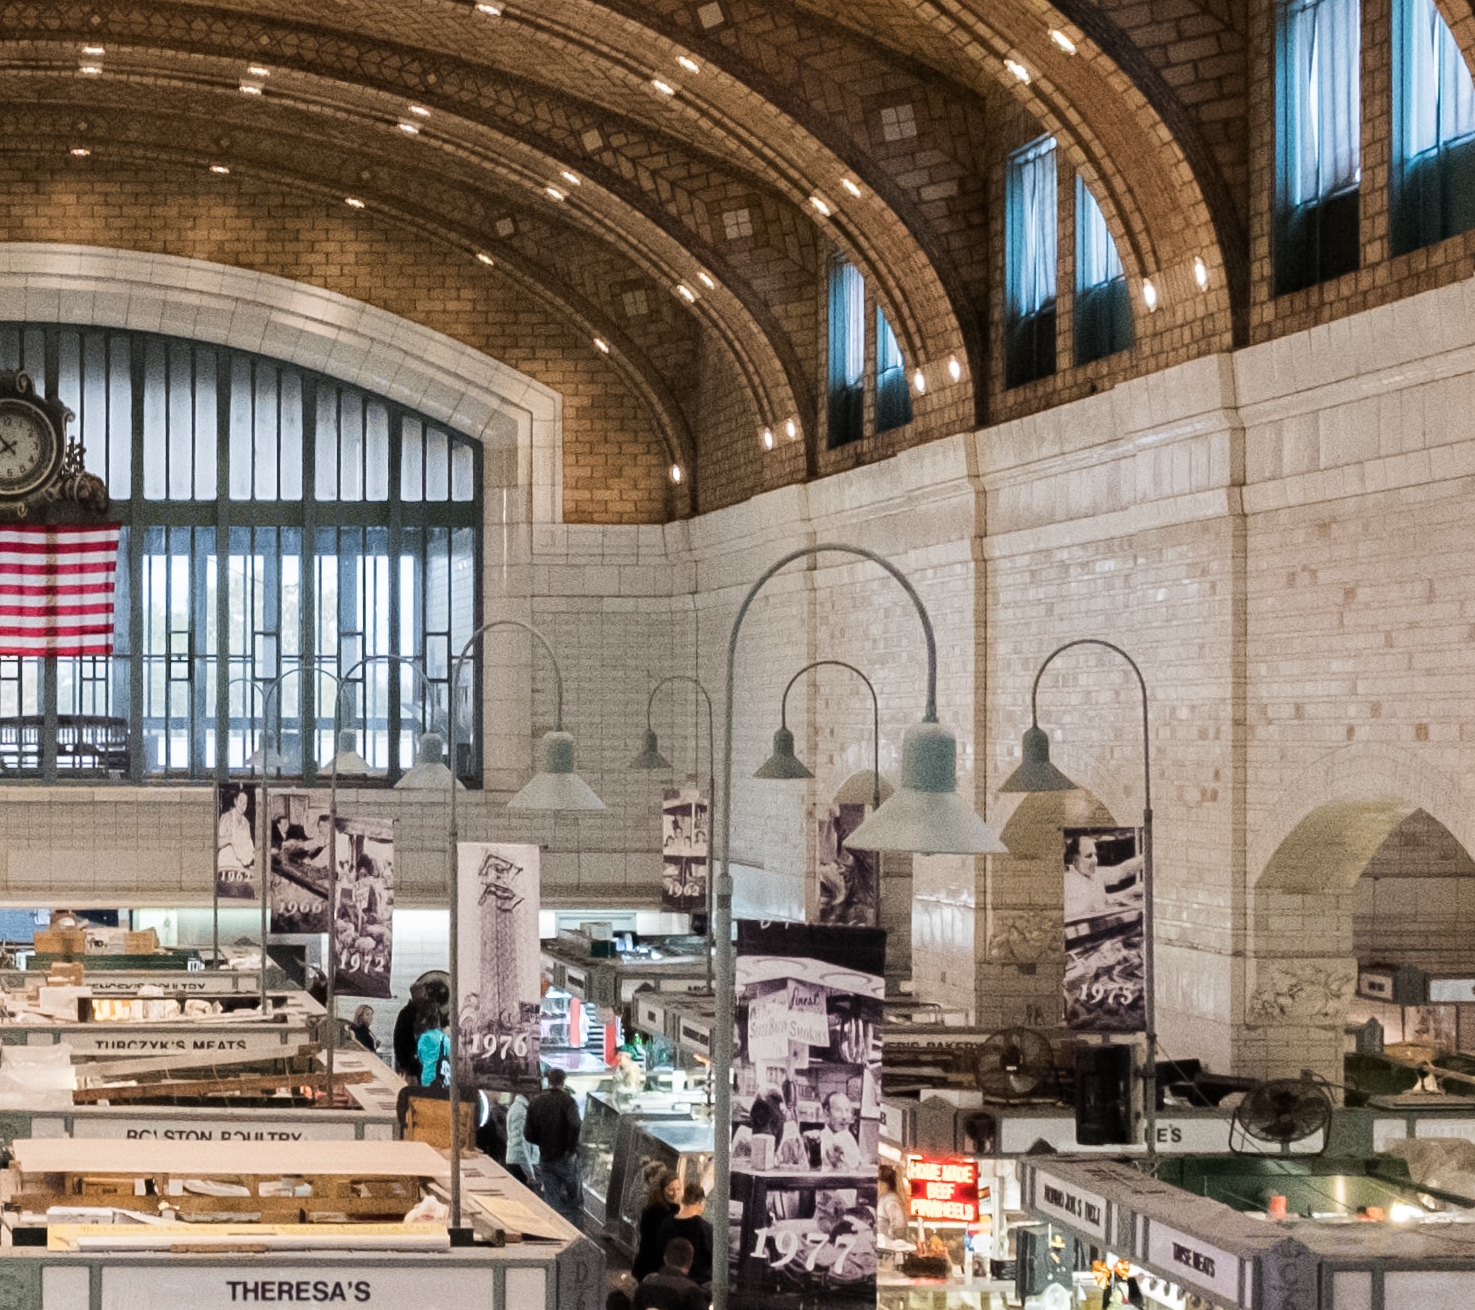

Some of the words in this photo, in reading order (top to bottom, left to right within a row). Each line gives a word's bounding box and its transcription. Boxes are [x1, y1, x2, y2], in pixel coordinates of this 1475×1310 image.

[278, 899, 322, 916] 1966
[339, 953, 385, 974] 1972
[1079, 982, 1133, 1008] 1975
[470, 1034, 528, 1061] 1976
[749, 1226, 859, 1273] 1977
[226, 1280, 371, 1302] THERESA'S
